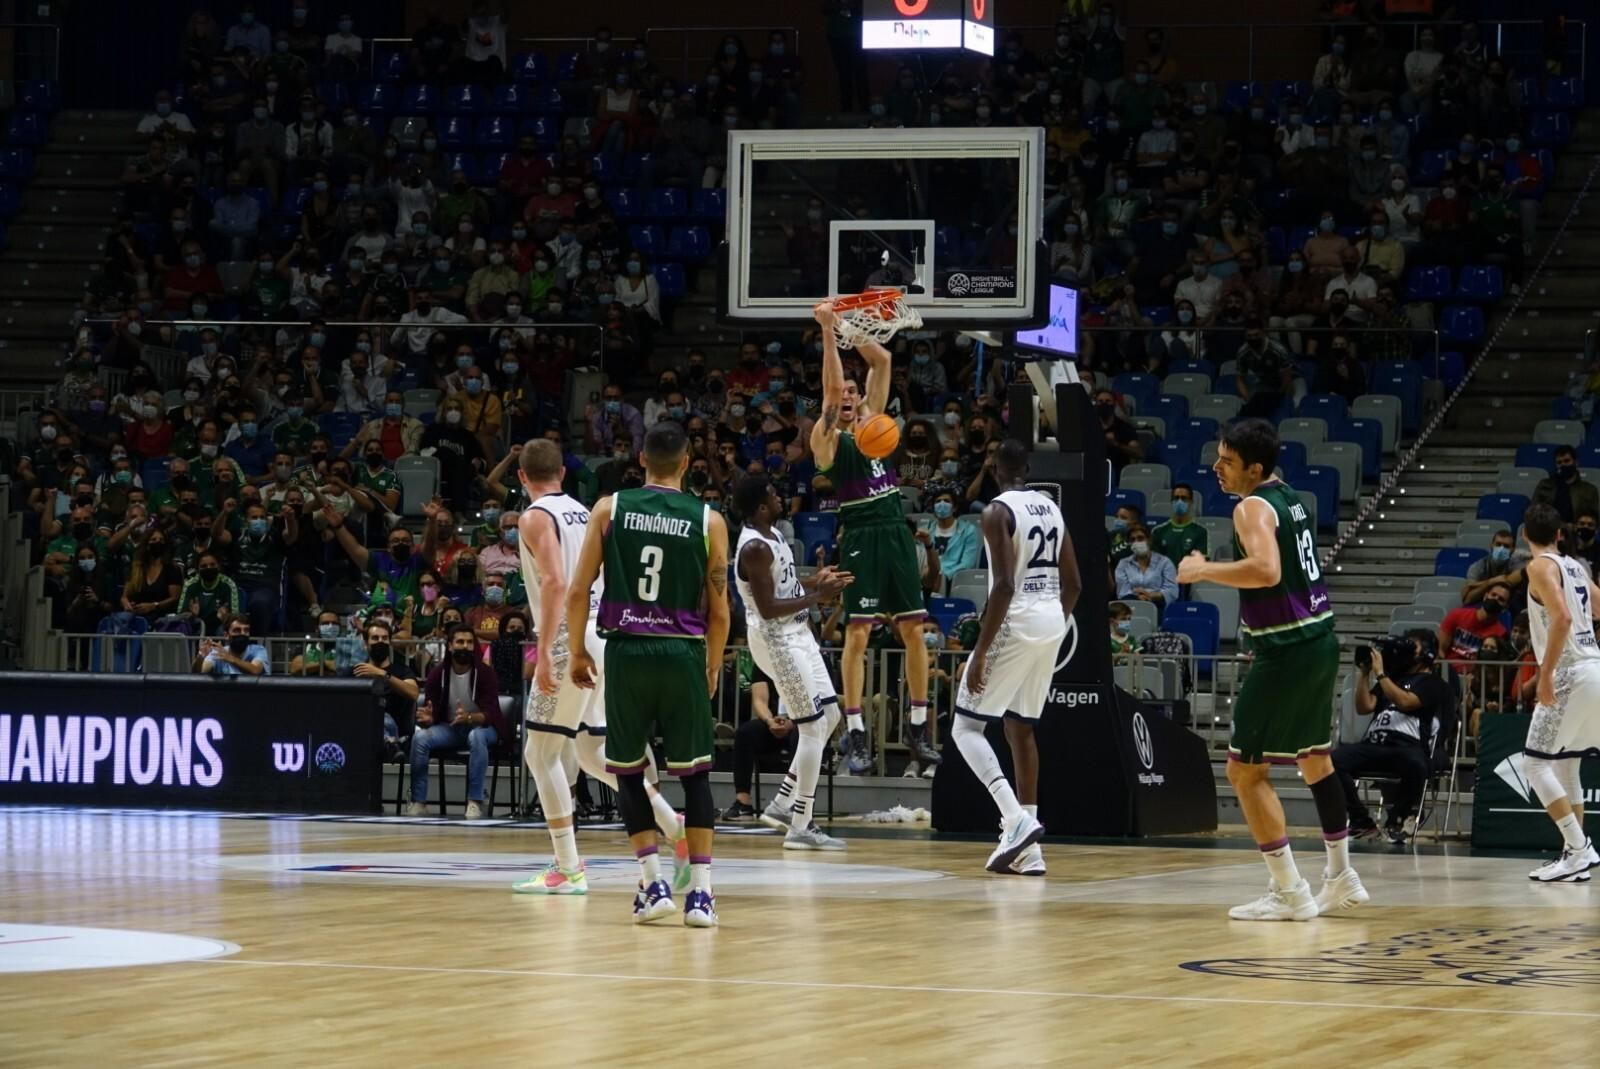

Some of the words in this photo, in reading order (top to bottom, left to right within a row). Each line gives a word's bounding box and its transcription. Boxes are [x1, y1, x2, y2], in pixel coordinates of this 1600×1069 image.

[624, 512, 692, 538] FERNÁNDEZ
[1027, 525, 1059, 568] 21
[638, 545, 664, 602] 3
